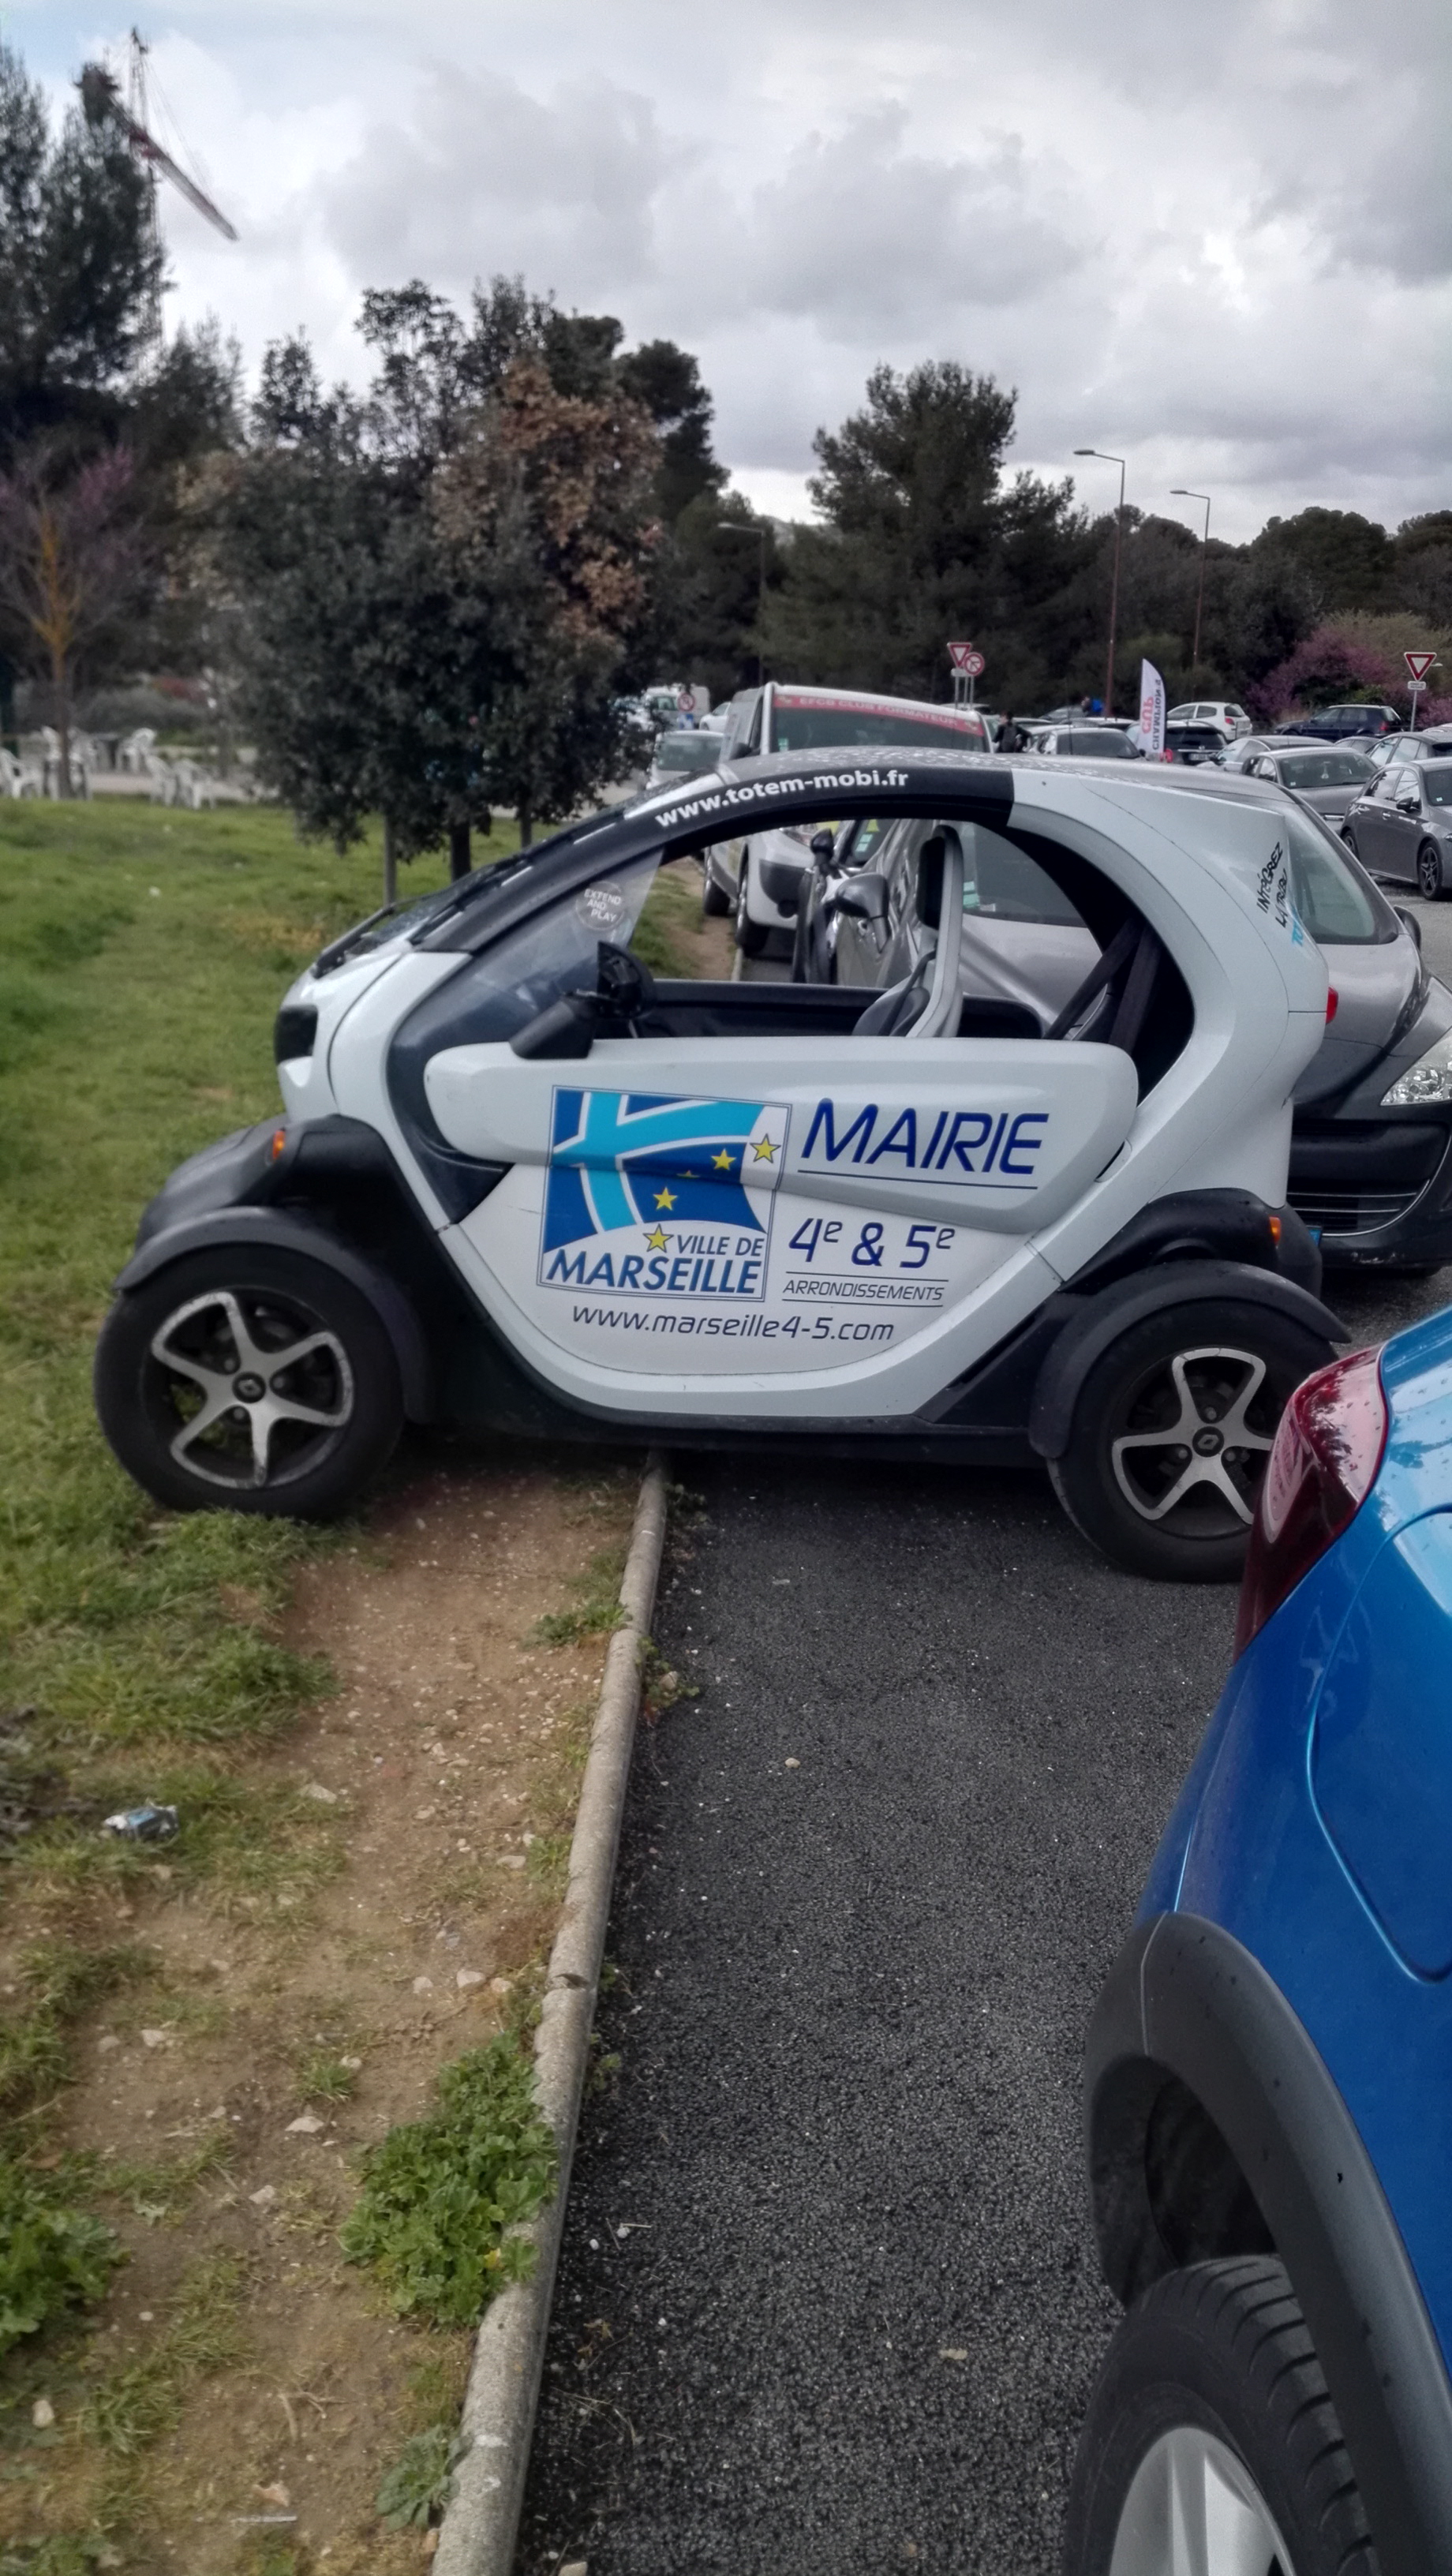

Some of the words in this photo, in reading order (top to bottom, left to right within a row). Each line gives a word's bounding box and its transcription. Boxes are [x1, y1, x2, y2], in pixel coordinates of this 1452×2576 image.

[838, 699, 874, 710] CLUB
[877, 705, 958, 726] FORMATEUR
[655, 769, 908, 828] www.totem-mobi.fr
[584, 889, 621, 905] EXTEND
[587, 899, 606, 910] AND
[590, 908, 616, 922] PLAY
[1275, 904, 1289, 928] LA
[801, 1098, 1050, 1175] MAIRIE
[676, 1234, 731, 1256] VILLE
[735, 1237, 765, 1257] DE
[851, 1222, 885, 1267] &
[545, 1248, 763, 1294] MARSEILLE
[782, 1279, 945, 1301] ARRONDISSEMENTS
[572, 1305, 896, 1341] www.marseille4-5.com
